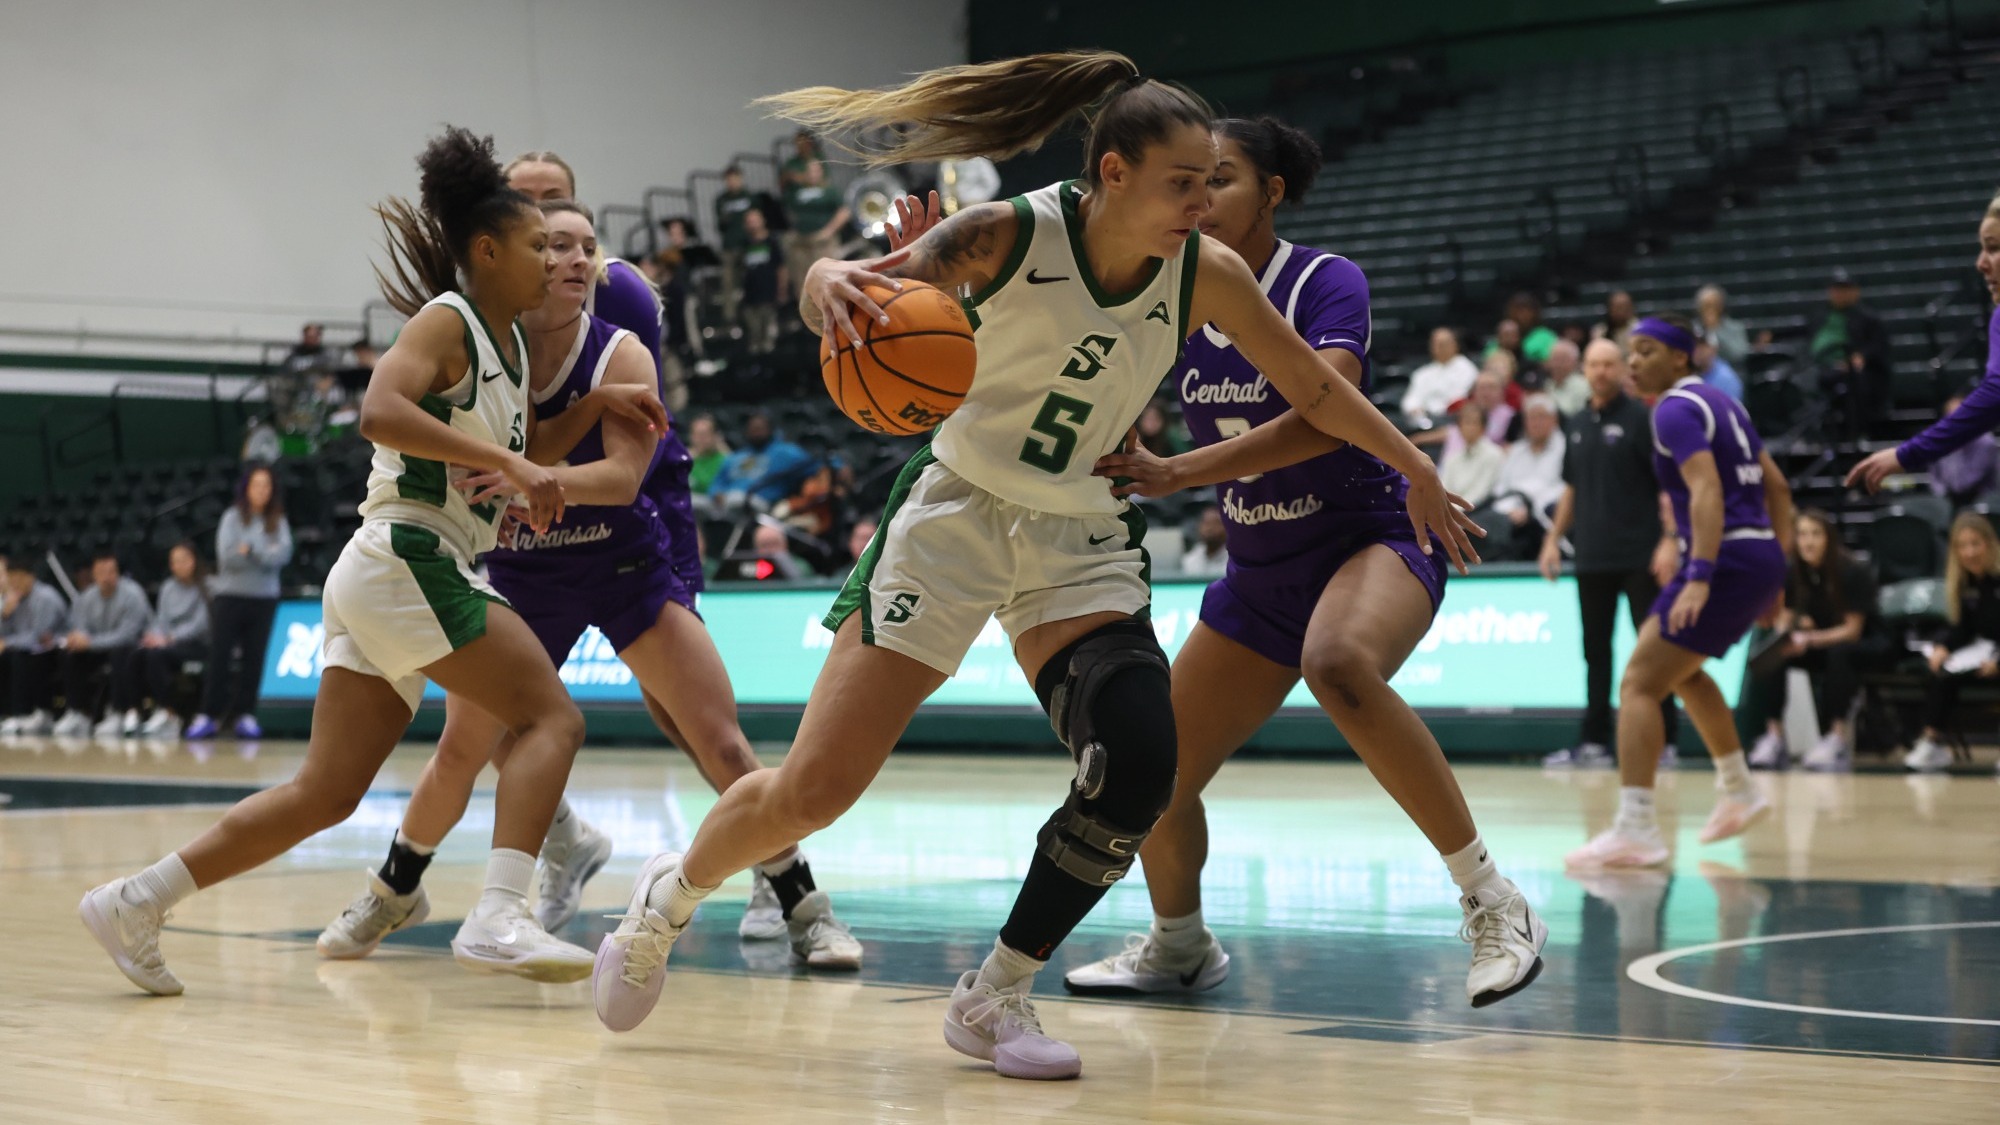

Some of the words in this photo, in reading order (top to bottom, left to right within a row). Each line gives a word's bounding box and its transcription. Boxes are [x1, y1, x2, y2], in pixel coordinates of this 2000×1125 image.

[1181, 368, 1269, 404] Central
[1018, 391, 1095, 474] 5
[1223, 487, 1324, 526] Arkansas
